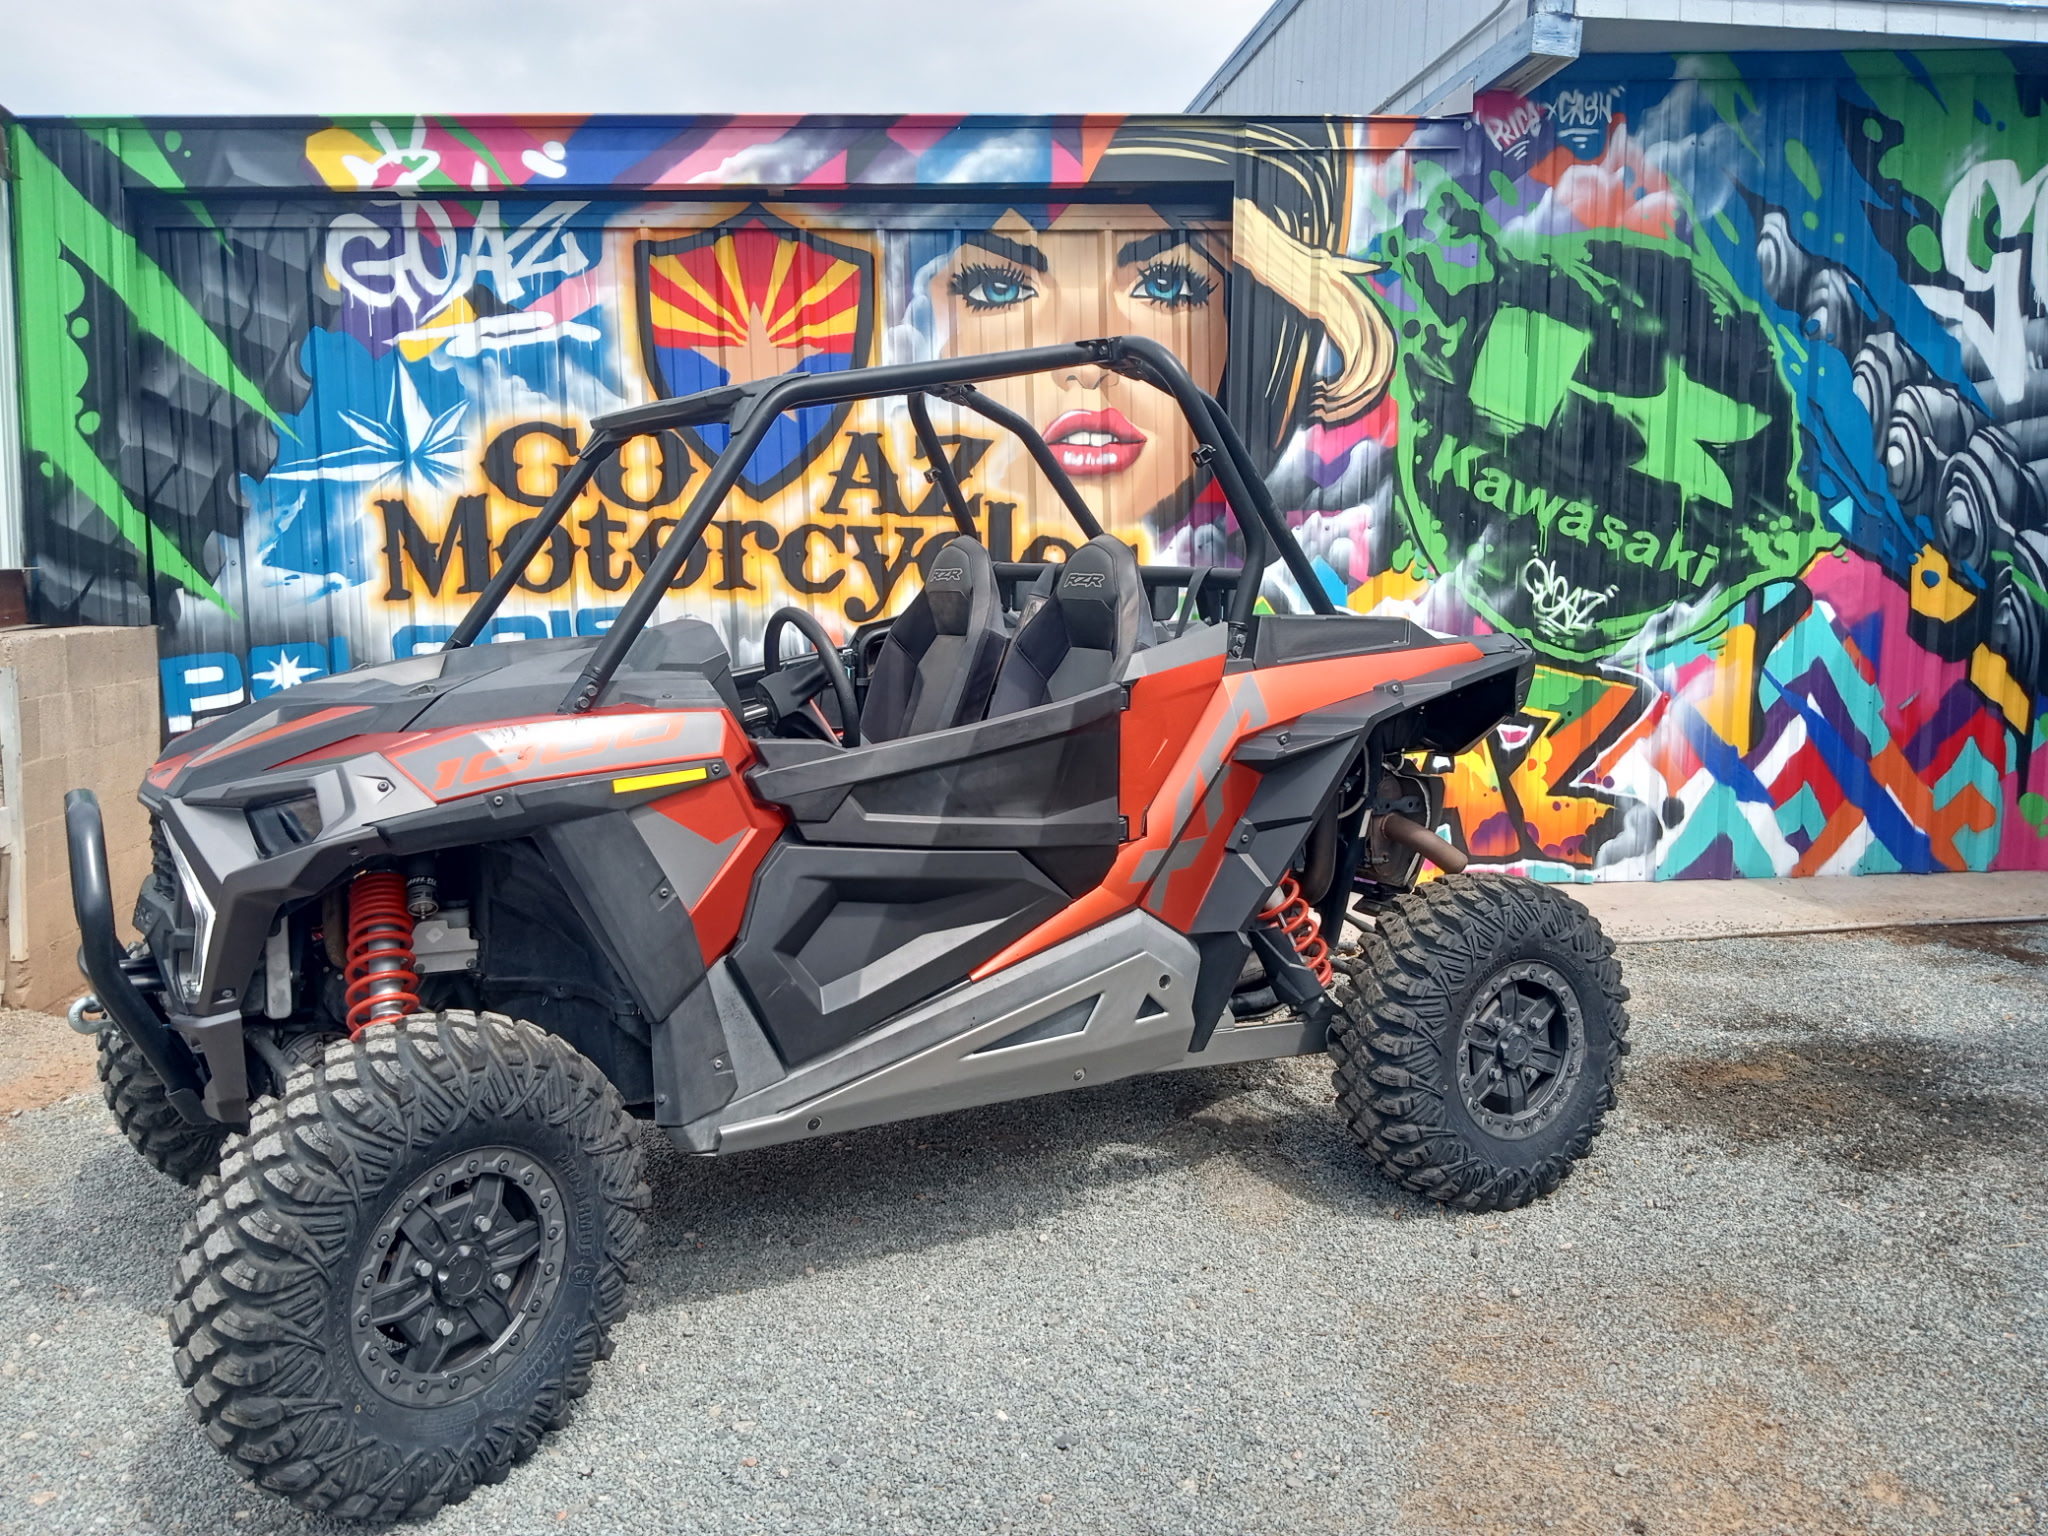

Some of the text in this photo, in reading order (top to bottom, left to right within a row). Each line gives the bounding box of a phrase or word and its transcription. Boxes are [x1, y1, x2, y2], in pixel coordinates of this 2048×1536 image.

[481, 421, 993, 517] GO AZ
[1428, 434, 1719, 587] Kawasaki
[930, 567, 963, 582] RZR
[1063, 572, 1106, 588] RZR
